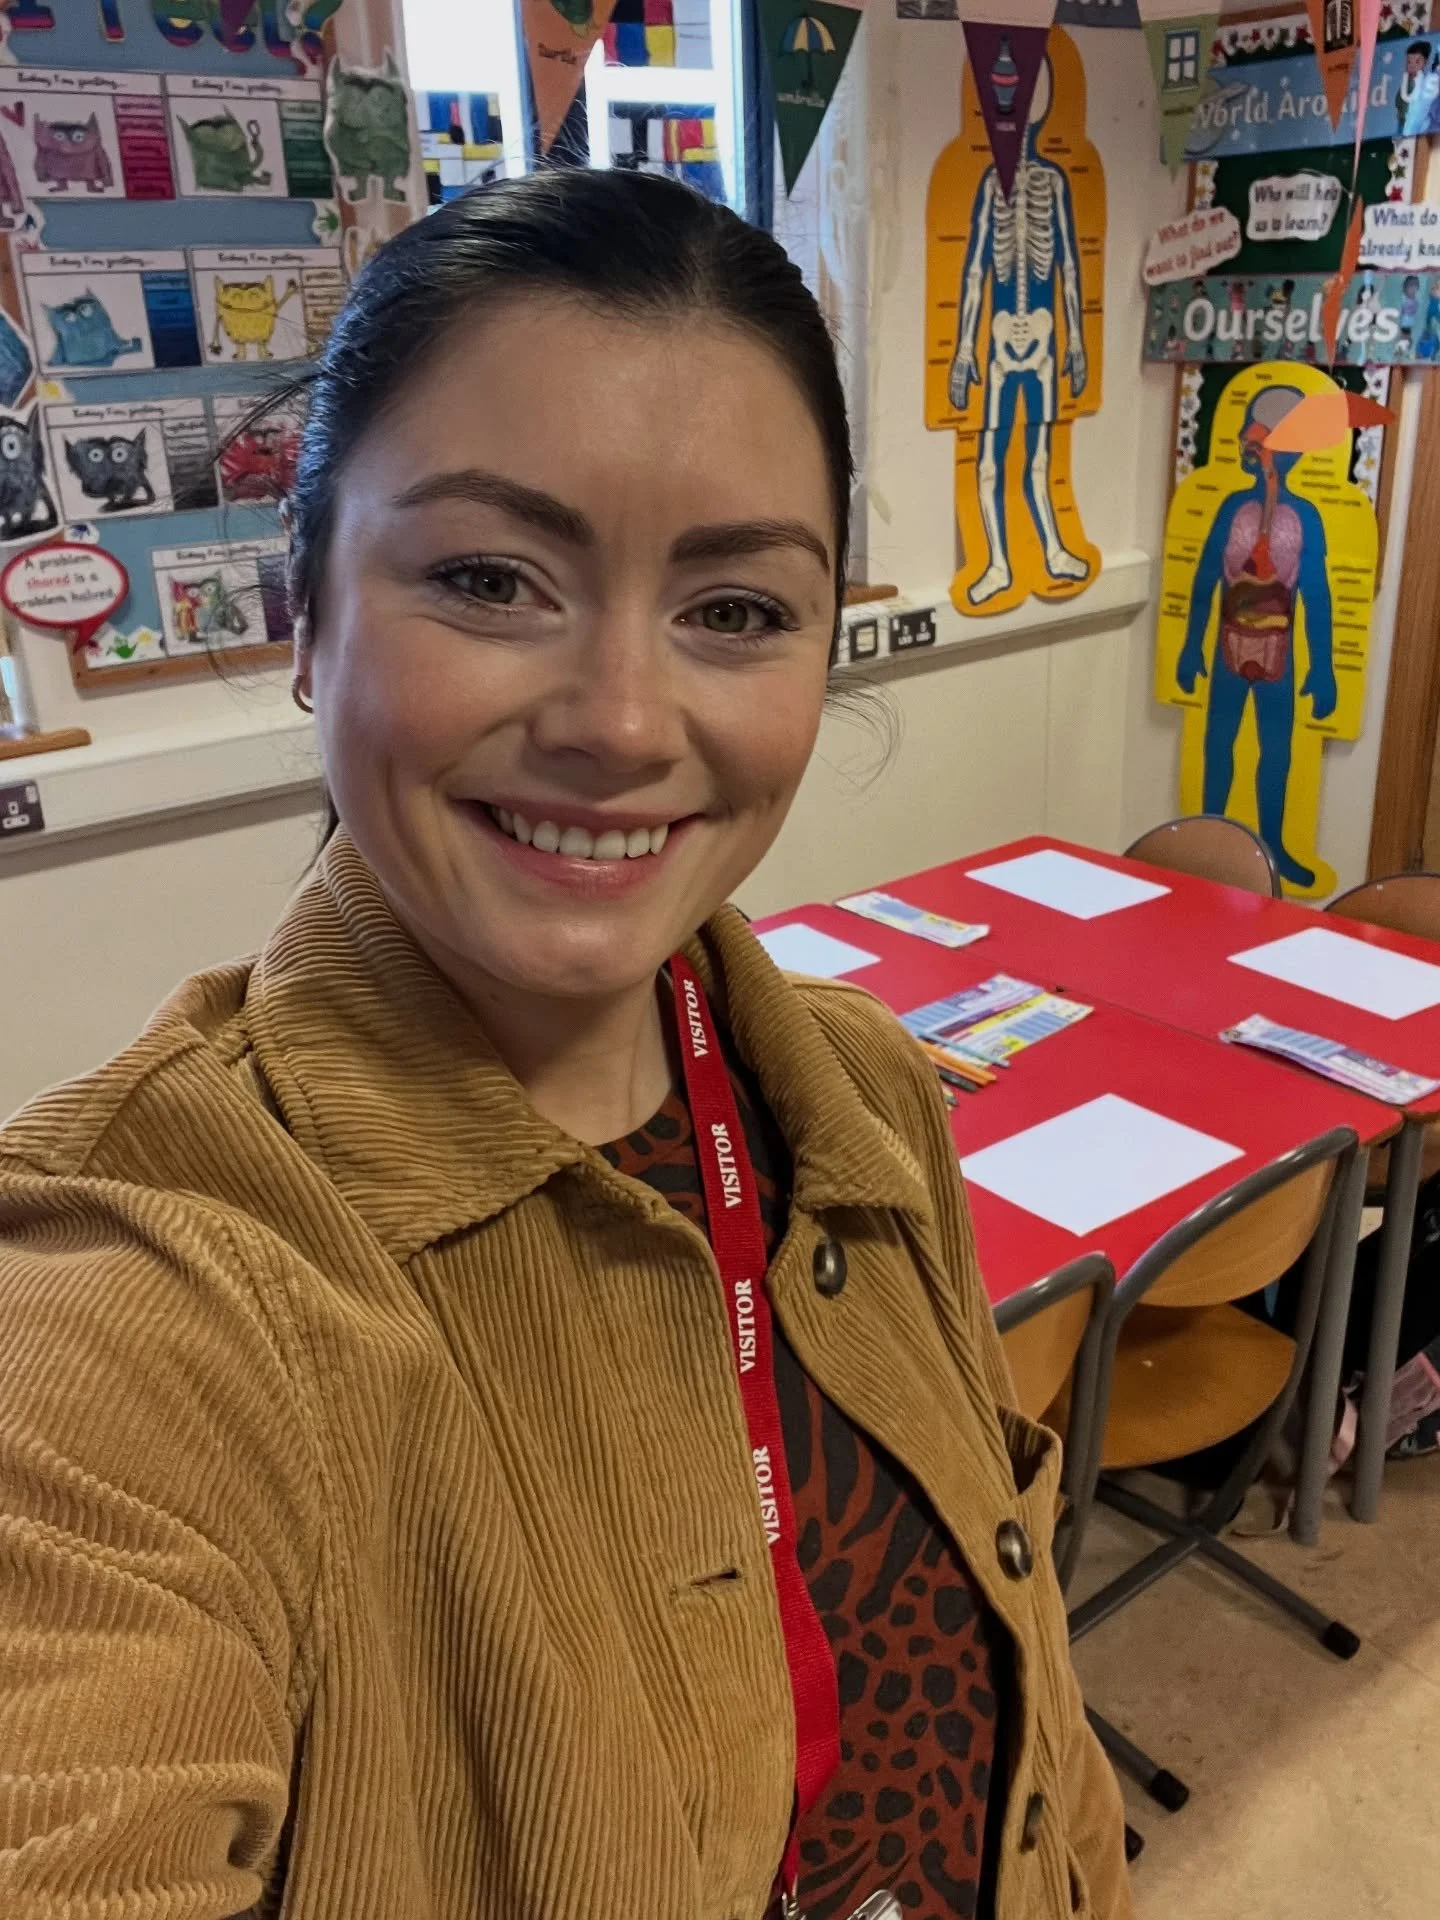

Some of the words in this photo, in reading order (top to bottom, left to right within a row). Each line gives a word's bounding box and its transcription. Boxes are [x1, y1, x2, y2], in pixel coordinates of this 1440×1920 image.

[1157, 223, 1189, 245] What
[1191, 215, 1206, 233] do
[1373, 207, 1415, 227] What
[1420, 207, 1438, 226] do
[682, 978, 709, 1058] VISITOR
[711, 1122, 743, 1209] VISITOR
[734, 1278, 757, 1374] VISITOR
[752, 1445, 782, 1544] VISITOR
